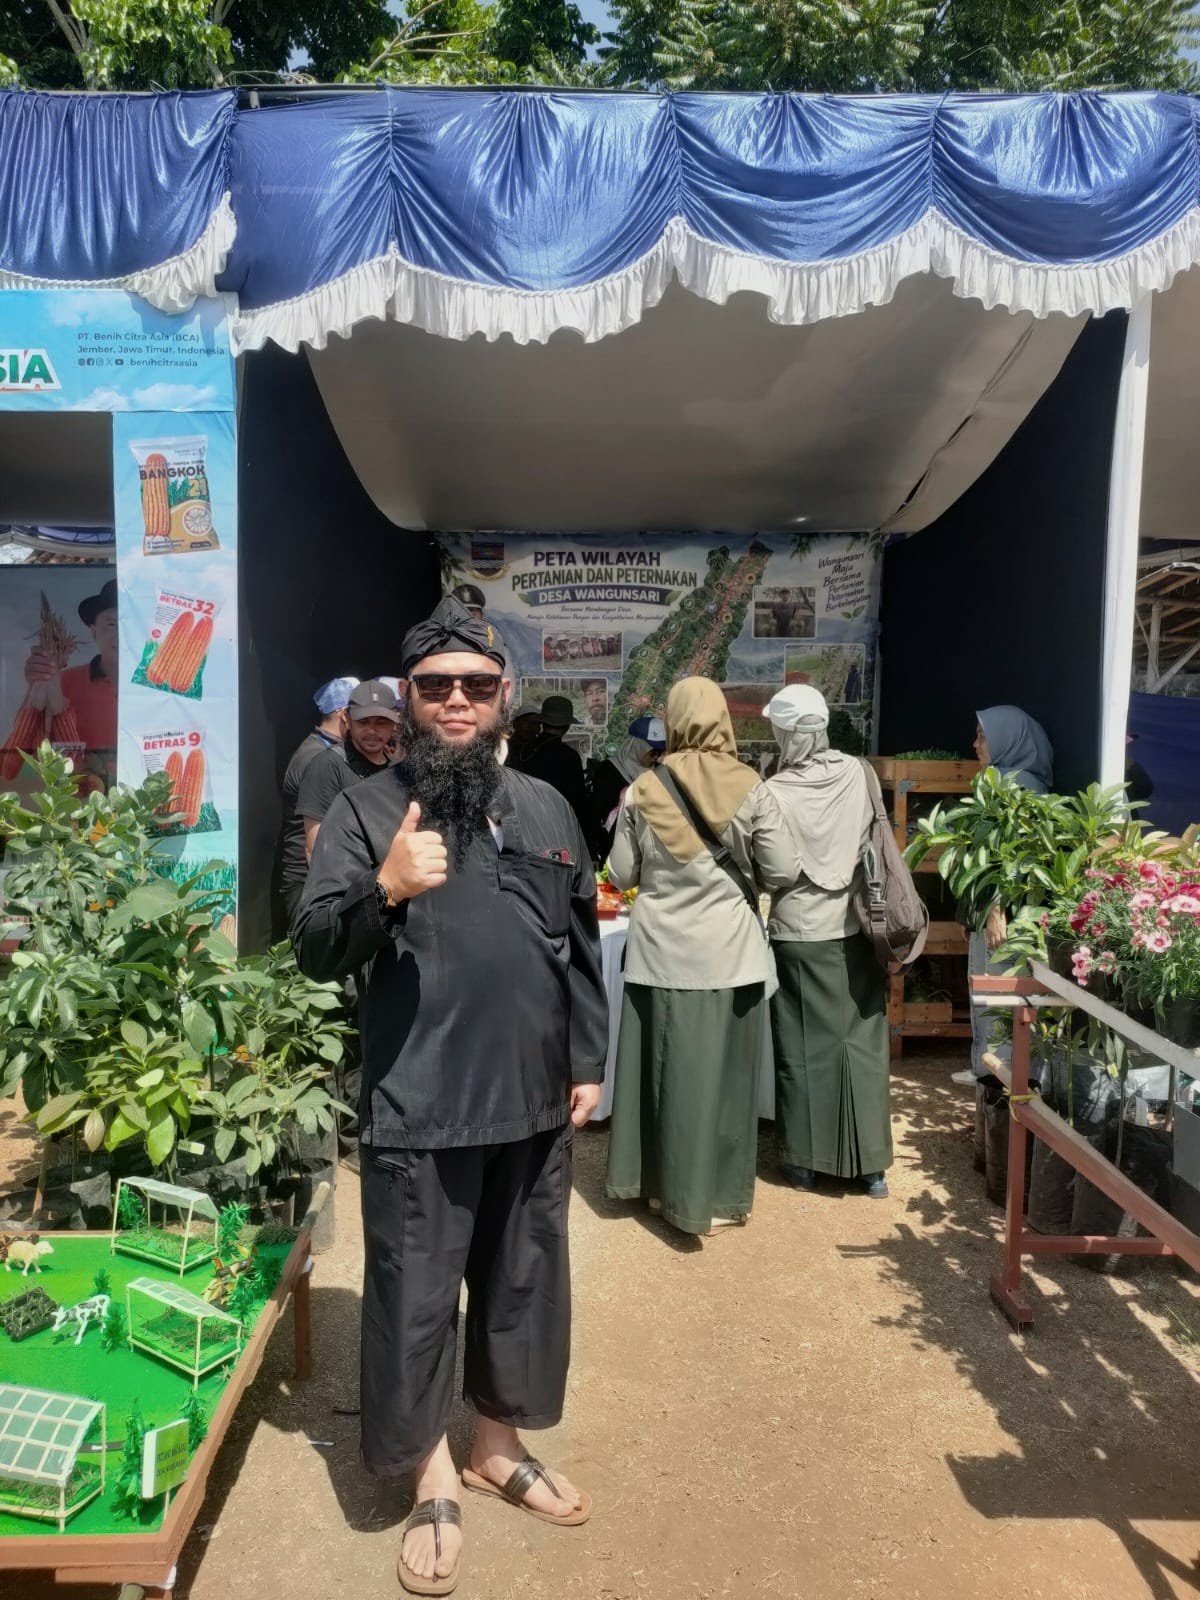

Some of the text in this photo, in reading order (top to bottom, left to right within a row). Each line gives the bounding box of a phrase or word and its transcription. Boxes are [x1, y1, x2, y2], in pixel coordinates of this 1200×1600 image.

[94, 333, 121, 341] Benih
[124, 333, 147, 341] Citra
[150, 333, 169, 341] Asia
[172, 334, 200, 343] (BCA)
[78, 346, 116, 354] Jember,
[118, 346, 142, 354] Jawa
[178, 347, 224, 355] Indonesia
[130, 358, 198, 367] benihcitraasia
[139, 465, 205, 480] BANGKOK
[189, 479, 207, 497] 21
[533, 552, 661, 566] PETA WILAYAH
[512, 568, 697, 591] PERTANIAN DAN PETERNAKAN
[539, 589, 660, 603] DESA WANGUNSARI
[159, 595, 193, 609] BETRAS
[193, 599, 215, 615] 32
[144, 732, 201, 750] BETRAS 9
